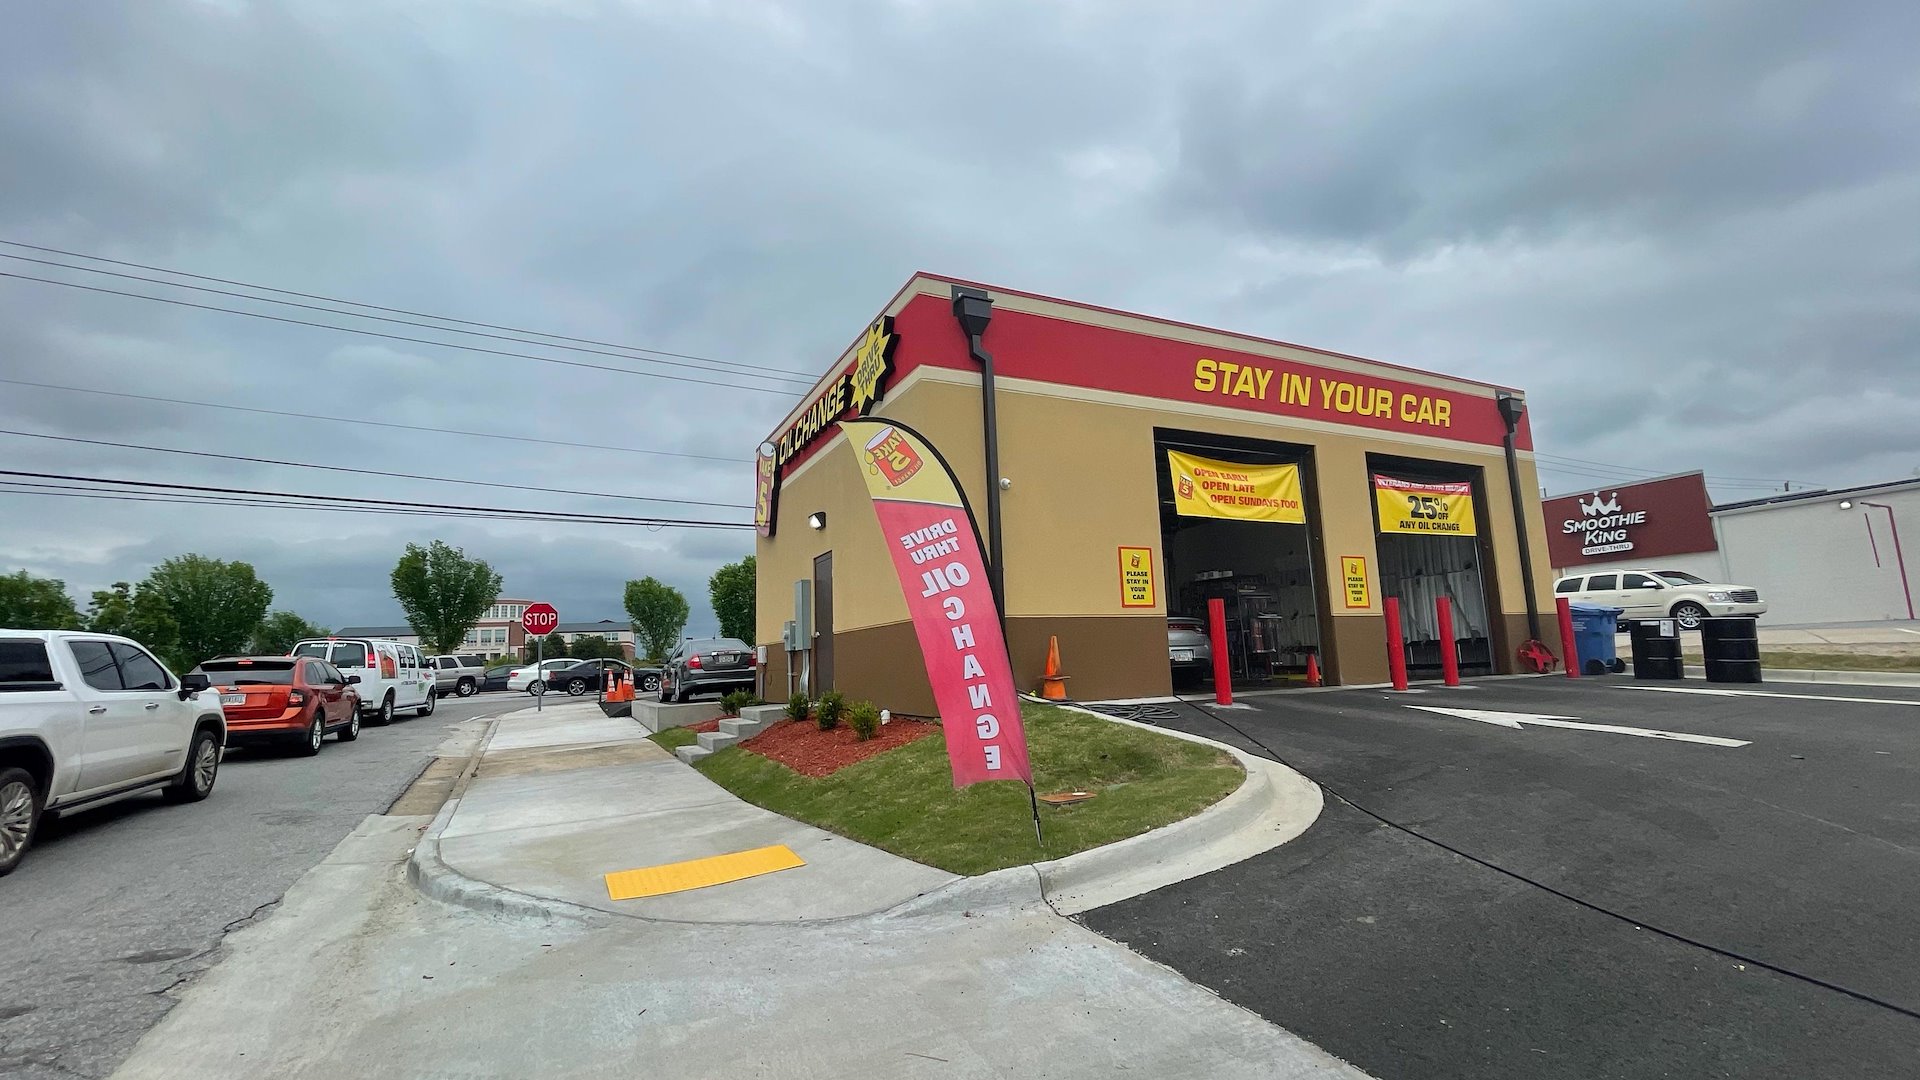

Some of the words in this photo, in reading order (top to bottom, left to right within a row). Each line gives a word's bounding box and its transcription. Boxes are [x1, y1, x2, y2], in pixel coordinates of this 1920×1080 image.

[857, 337, 880, 385] DRIVE
[860, 354, 880, 395] THRU
[1194, 359, 1273, 400] STAY
[1280, 372, 1312, 407] IN
[1319, 378, 1393, 419] YOUR
[1400, 394, 1451, 427] CAR
[778, 428, 796, 466] OIL
[795, 375, 847, 453] CHANGE
[1194, 467, 1220, 479] OPEN
[1220, 472, 1248, 482] EARLY
[1202, 481, 1230, 492] OPEN
[1233, 484, 1255, 493] LATE
[757, 481, 768, 526] 5
[1210, 494, 1236, 505] OPEN
[1238, 496, 1279, 508] SUNDAYS
[1280, 499, 1299, 509] TOO!
[1407, 495, 1449, 520] 25%
[1437, 512, 1449, 520] OFF
[1562, 511, 1646, 534] SMOOTHIE
[1399, 520, 1416, 529] ANY
[1418, 521, 1430, 530] OIL
[1432, 522, 1460, 532] CHANGE
[1584, 543, 1631, 555] DRIVE-THRU
[524, 612, 557, 626] STOP
